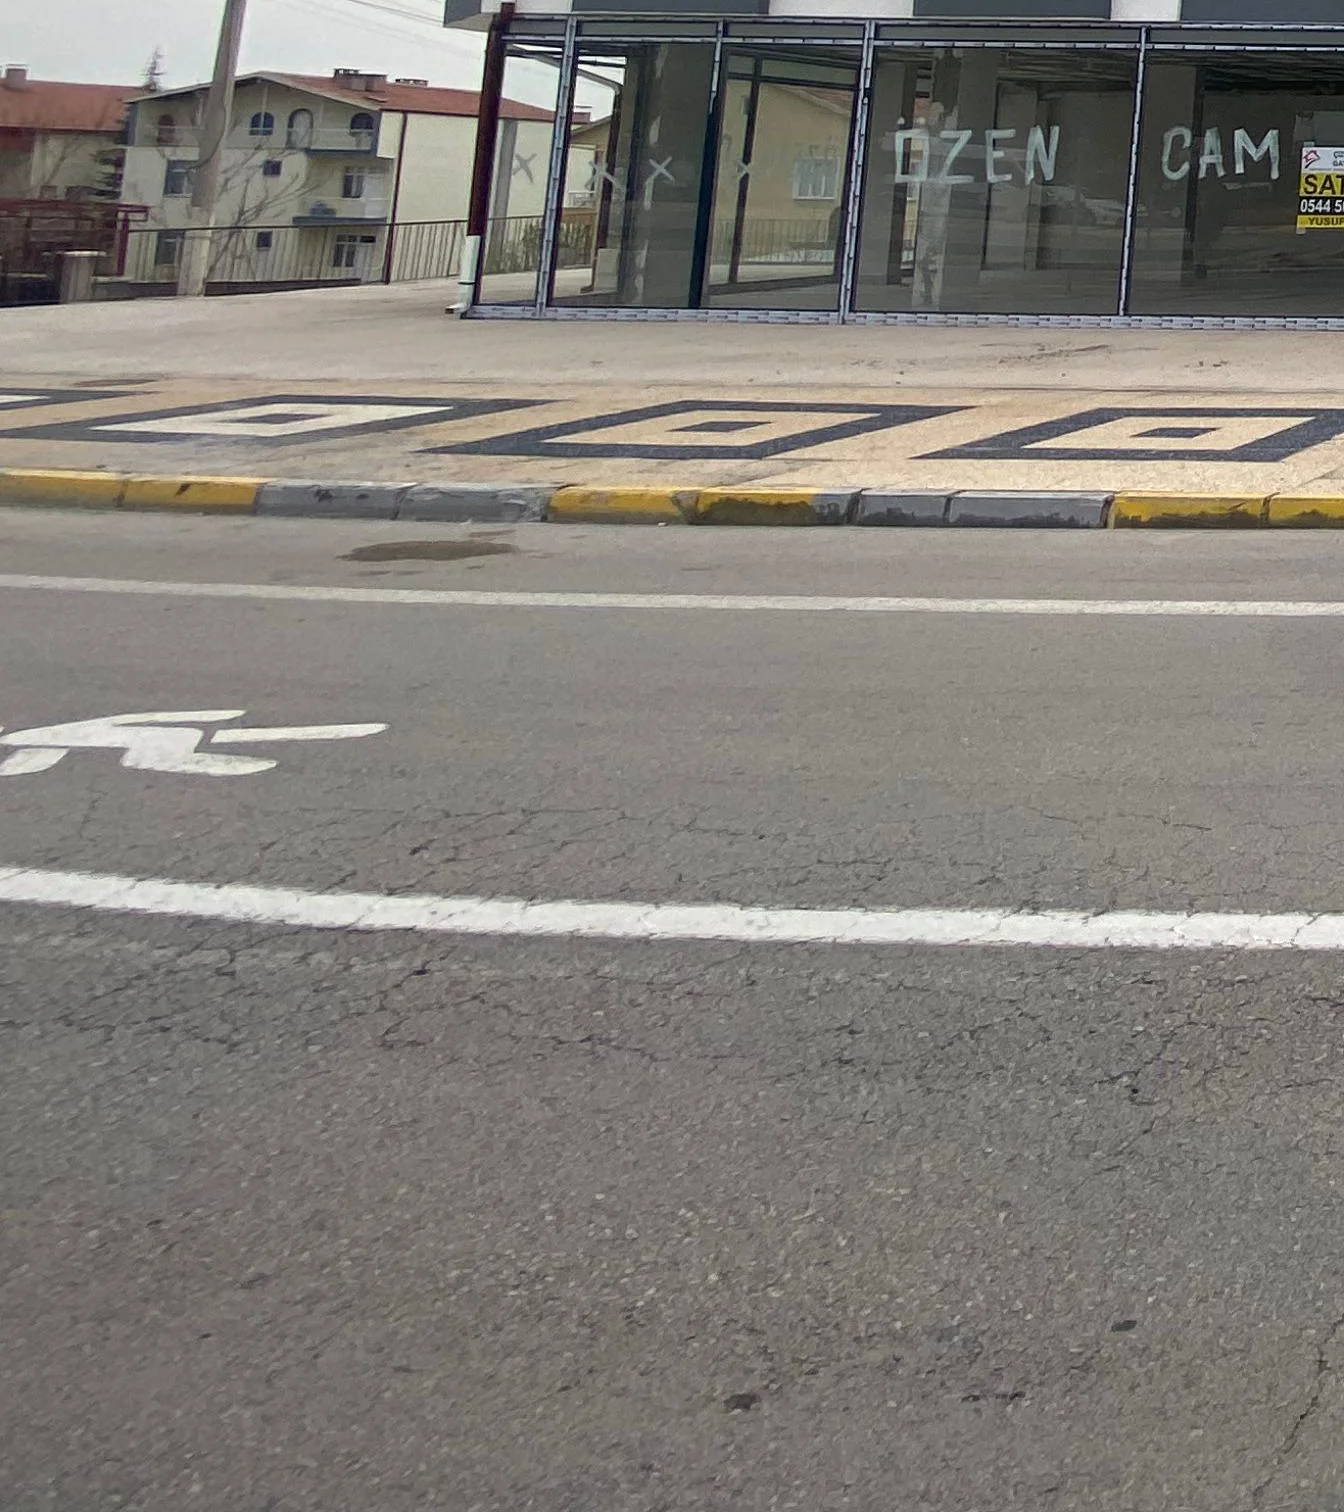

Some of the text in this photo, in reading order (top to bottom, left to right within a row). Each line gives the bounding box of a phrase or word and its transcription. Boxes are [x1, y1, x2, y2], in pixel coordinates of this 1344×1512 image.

[894, 117, 1280, 185] ÖZEN CAM
[1300, 199, 1331, 213] 0544
